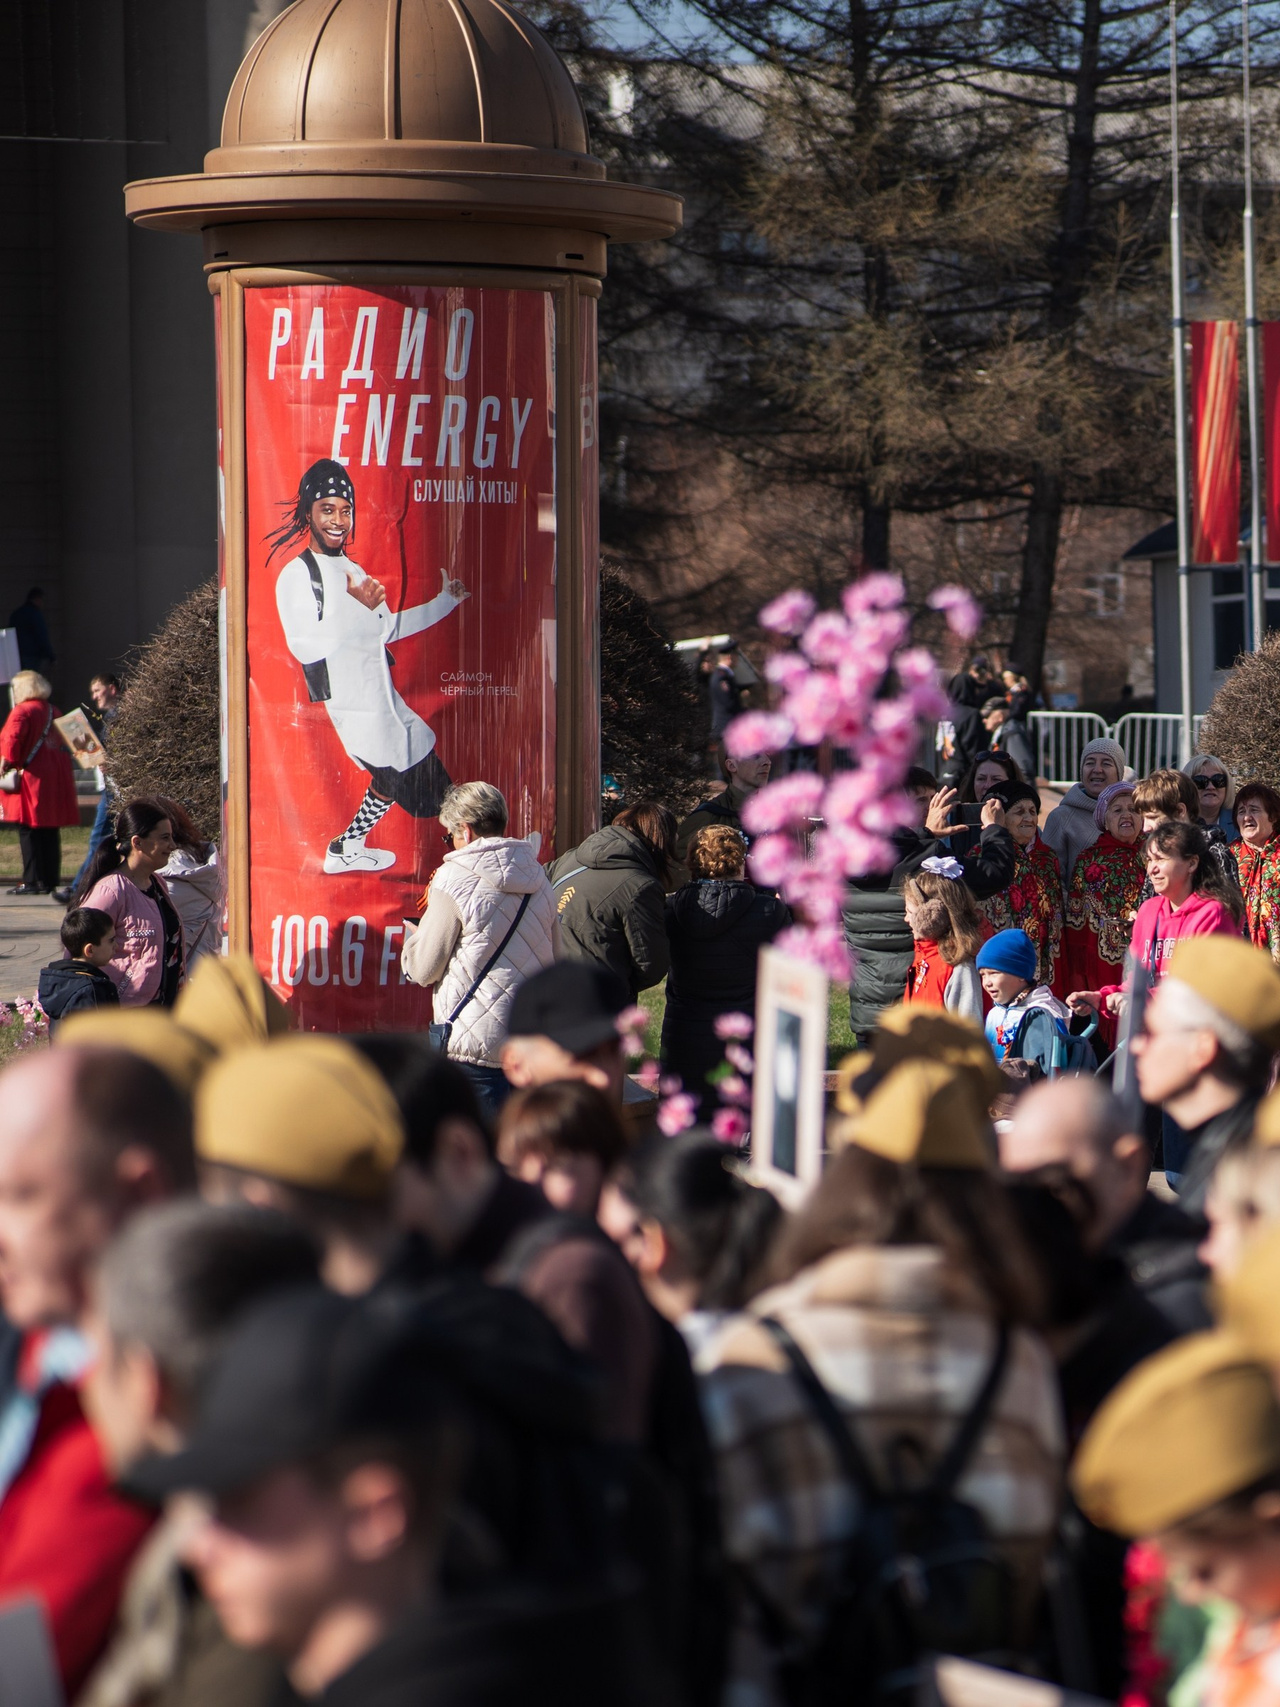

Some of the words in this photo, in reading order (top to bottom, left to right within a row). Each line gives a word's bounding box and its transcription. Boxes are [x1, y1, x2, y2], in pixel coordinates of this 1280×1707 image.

[267, 306, 475, 389] РАДИО
[330, 393, 534, 469] ENERGY
[413, 475, 475, 503] СЛУШАЙ
[478, 480, 518, 504] ХИТЫ!
[440, 670, 493, 682] САЙМОН
[440, 684, 484, 696] ЧЁРНЫЙ
[487, 686, 518, 697] ПЕРЕЦ
[270, 914, 367, 987] 100.6
